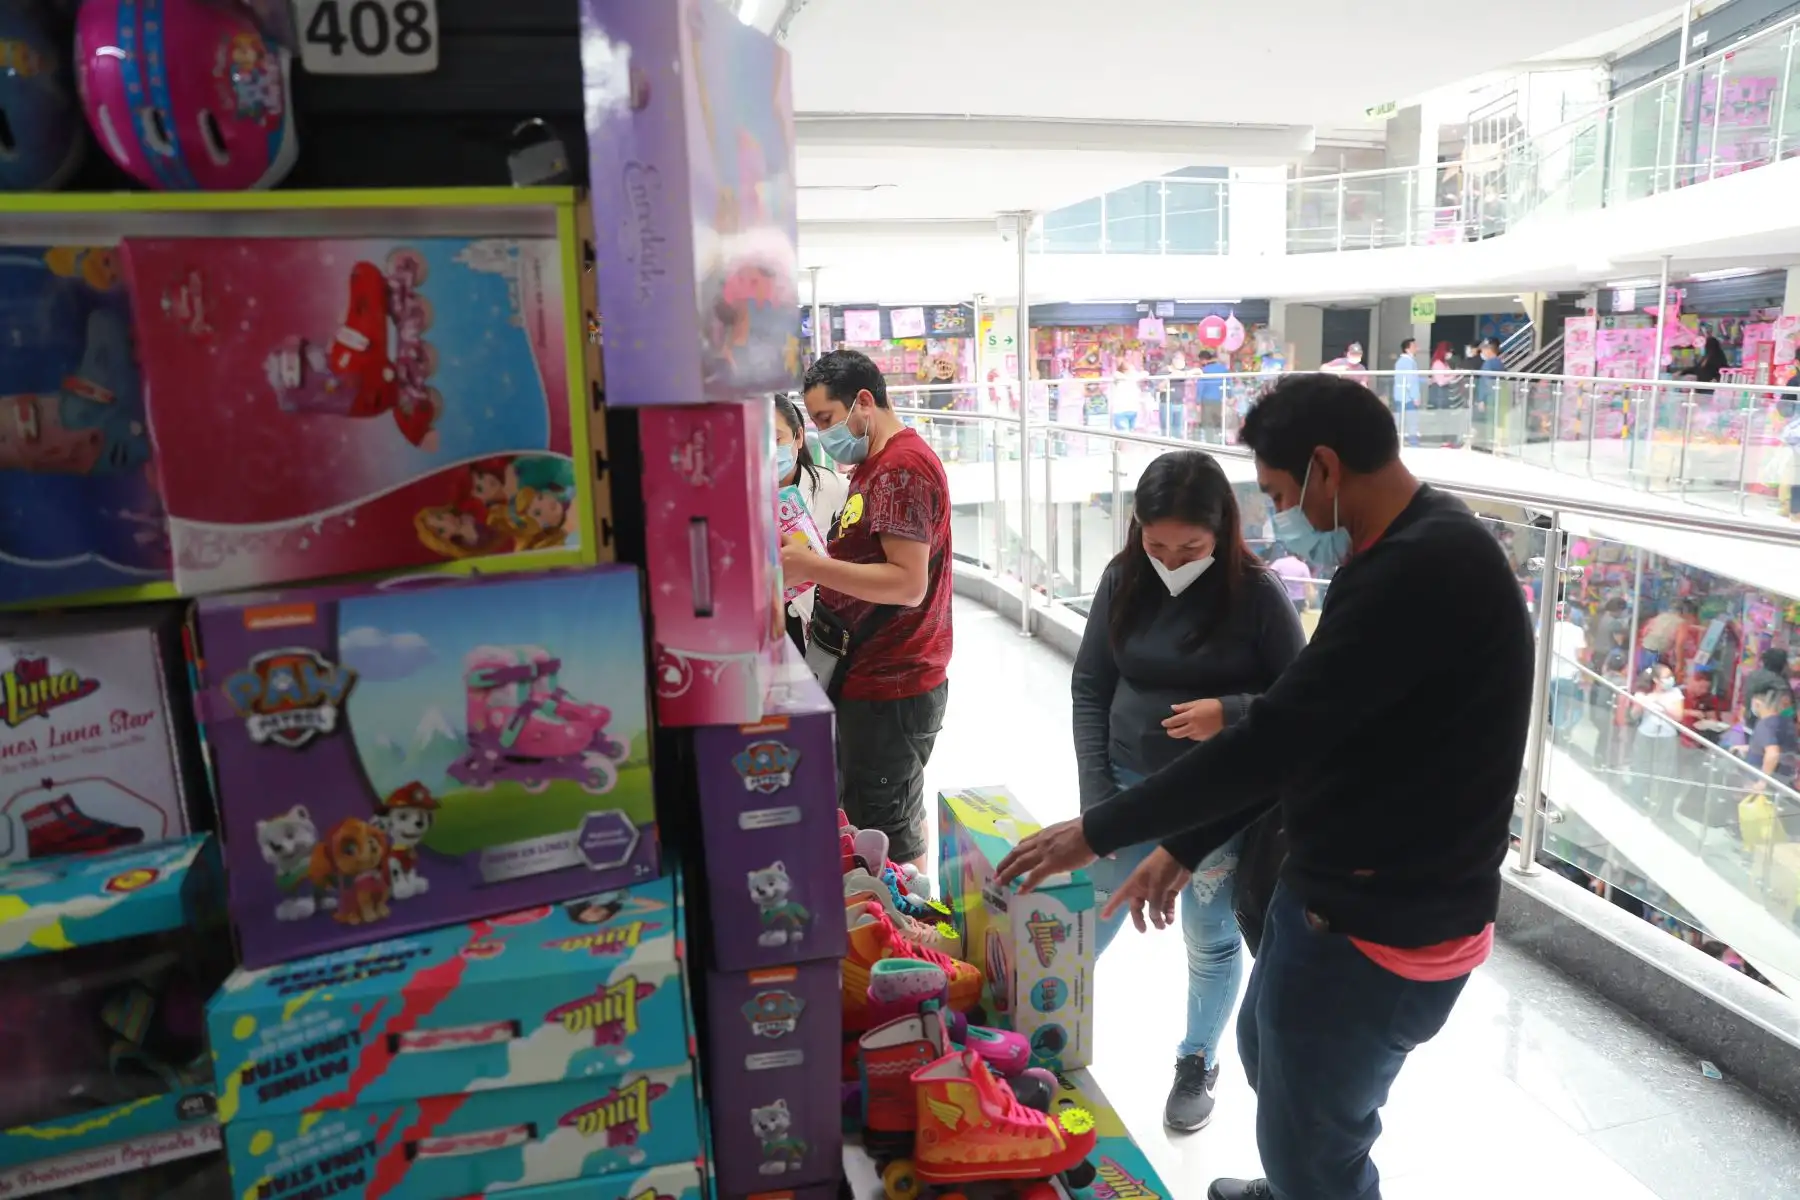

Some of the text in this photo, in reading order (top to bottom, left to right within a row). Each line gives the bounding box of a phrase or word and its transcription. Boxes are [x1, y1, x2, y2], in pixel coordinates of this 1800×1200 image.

[306, 0, 432, 57] 408
[988, 335, 998, 346] S
[1, 668, 81, 729] Luna
[222, 656, 361, 717] PAW
[47, 721, 103, 749] Luna
[109, 706, 156, 736] Star
[562, 972, 638, 1035] Luna
[240, 1051, 298, 1087] STAR
[575, 1074, 651, 1138] Luna
[257, 1163, 315, 1200] STAR
